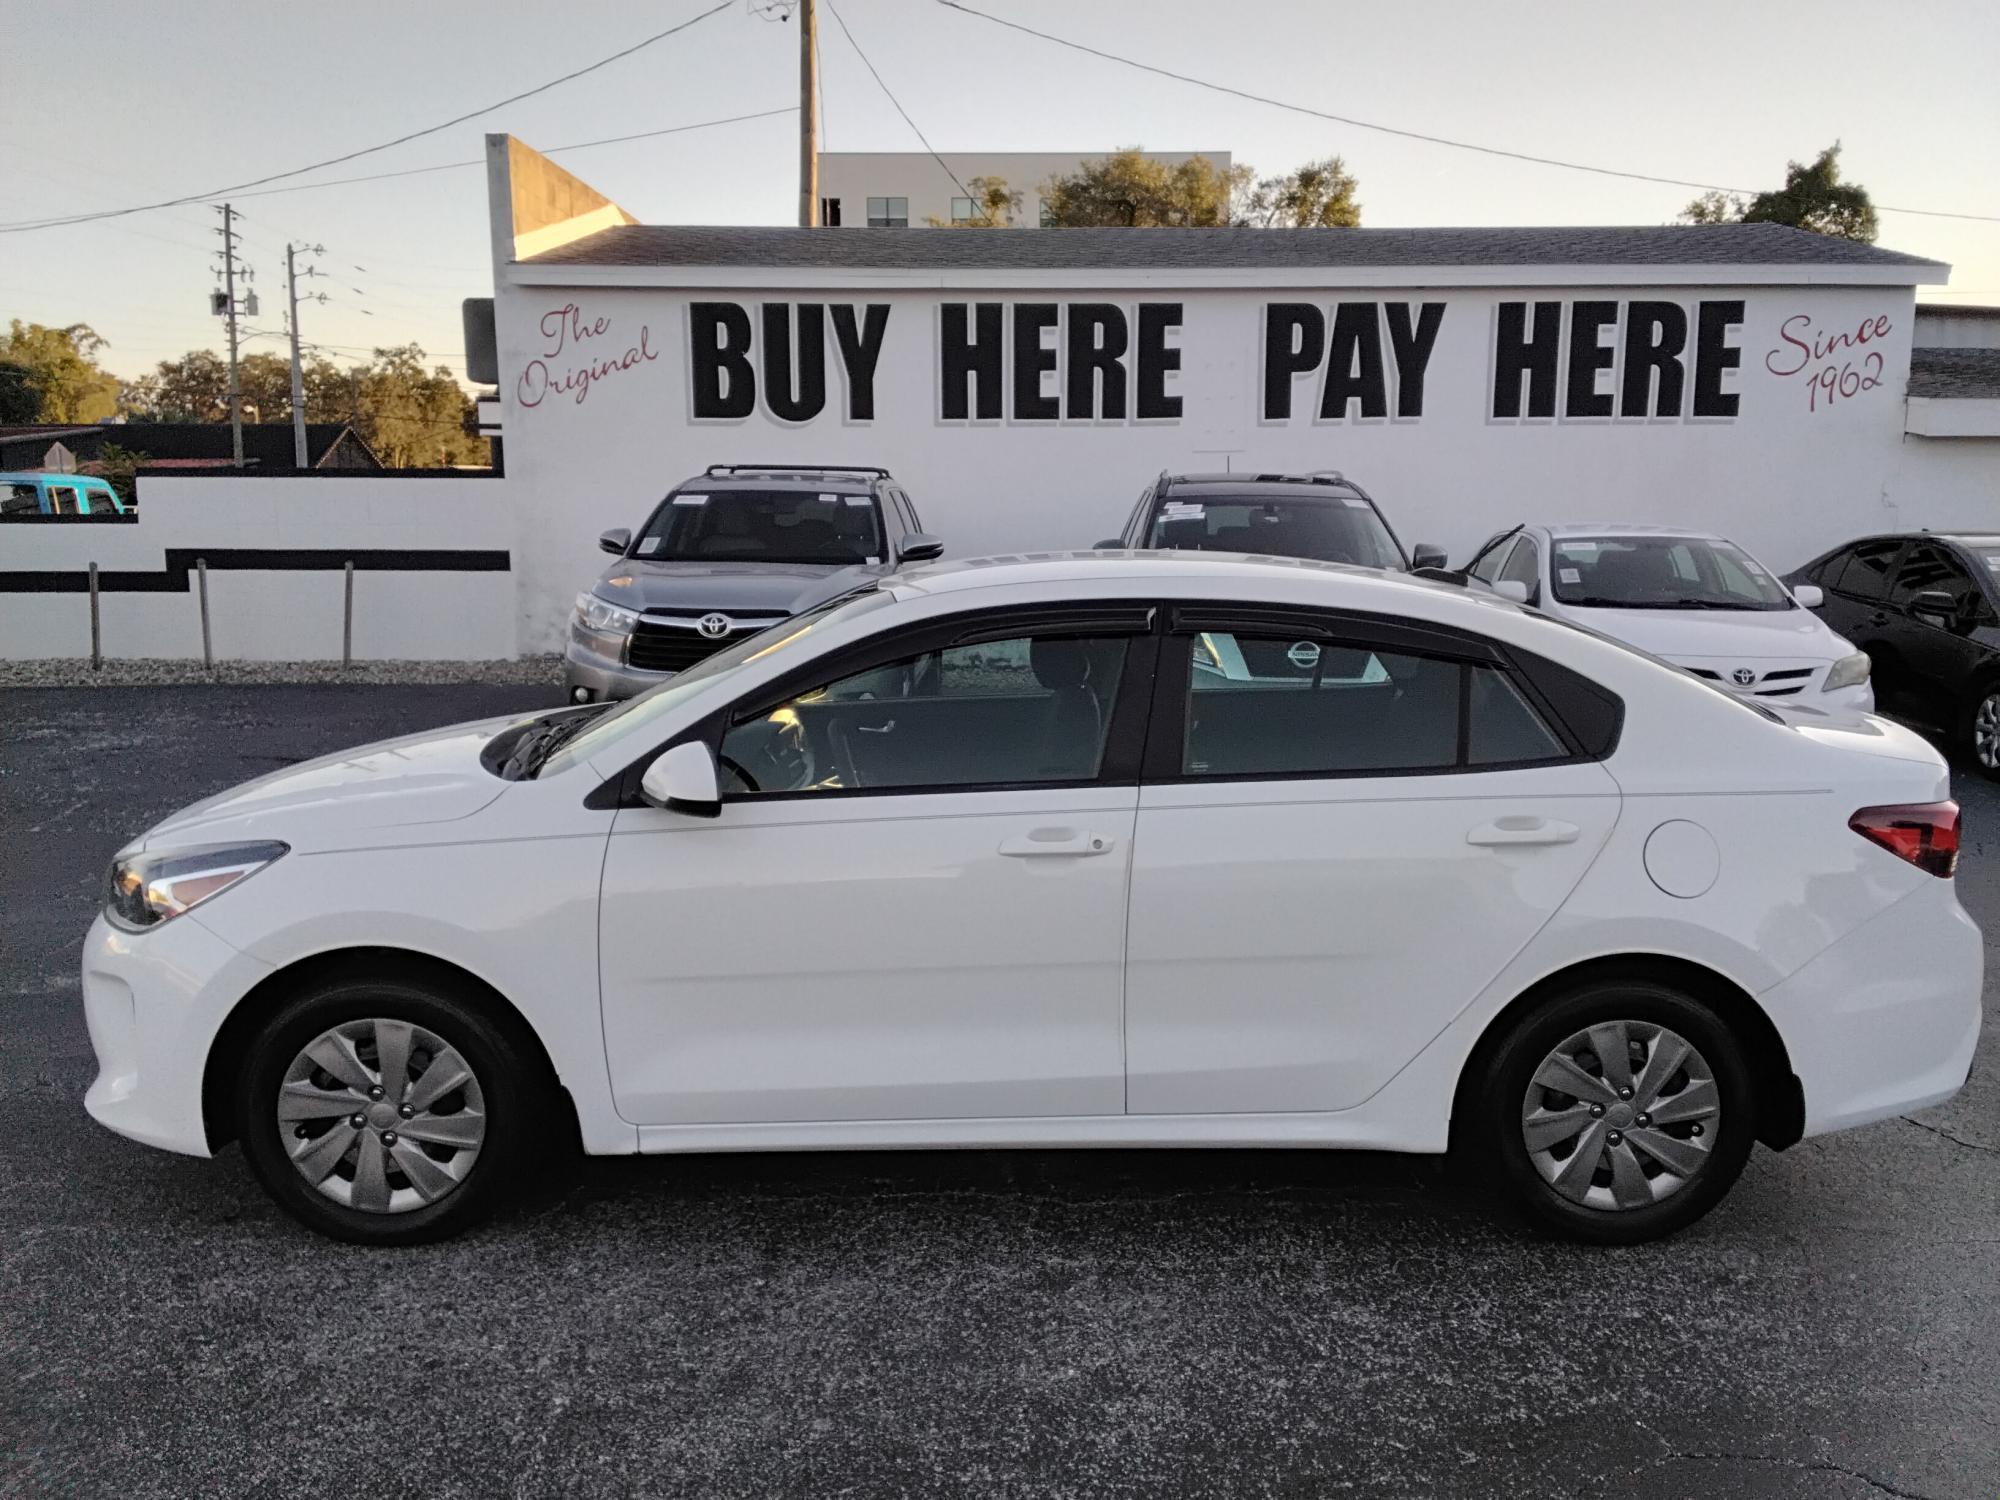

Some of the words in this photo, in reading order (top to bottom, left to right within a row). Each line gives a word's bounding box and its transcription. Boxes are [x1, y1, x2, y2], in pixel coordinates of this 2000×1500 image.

[540, 302, 612, 359] The
[688, 301, 892, 422] BUY
[939, 301, 1185, 421] HERE
[1263, 301, 1448, 420] PAY
[1492, 299, 1746, 418] HERE
[1765, 314, 1893, 376] Since
[516, 324, 660, 408] Original
[1805, 351, 1884, 413] 1962
